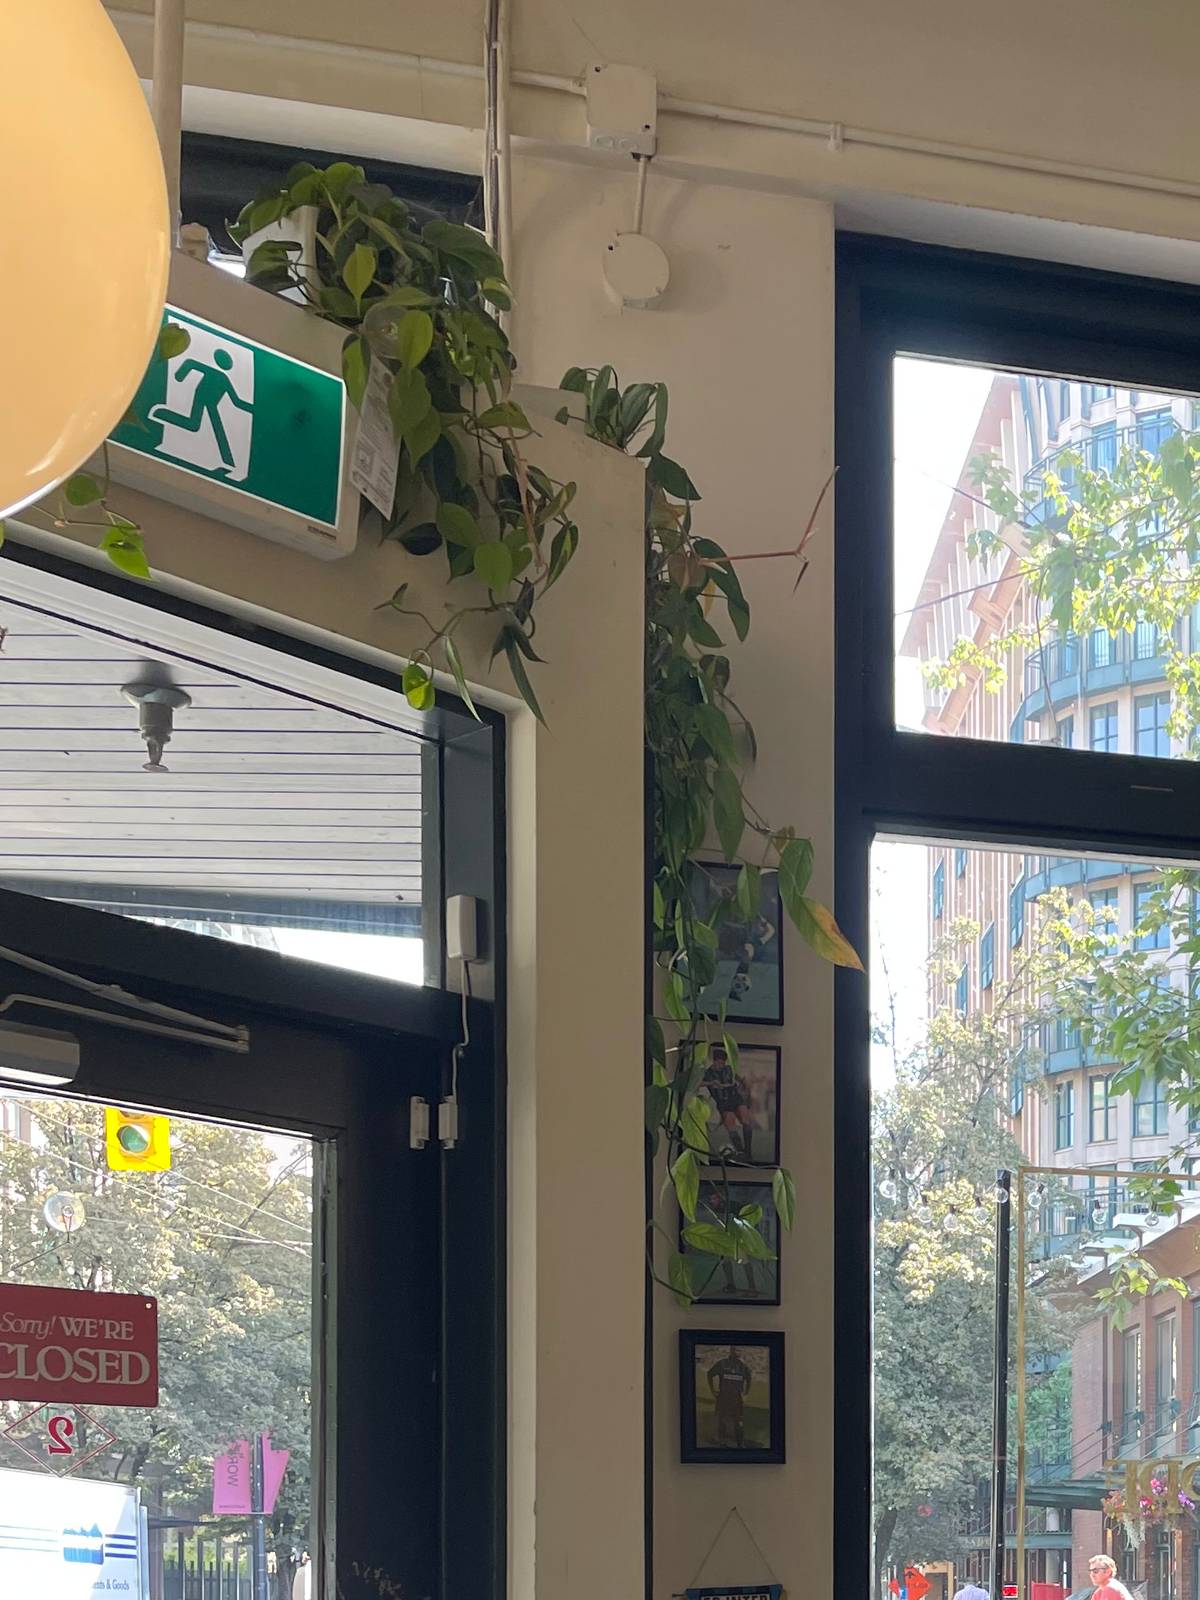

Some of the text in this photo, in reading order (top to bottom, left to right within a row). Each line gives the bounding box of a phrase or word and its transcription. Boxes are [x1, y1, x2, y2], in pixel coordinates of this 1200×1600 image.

[1, 1311, 135, 1341] Sorry! WE'RE
[0, 1343, 151, 1386] CLOSED
